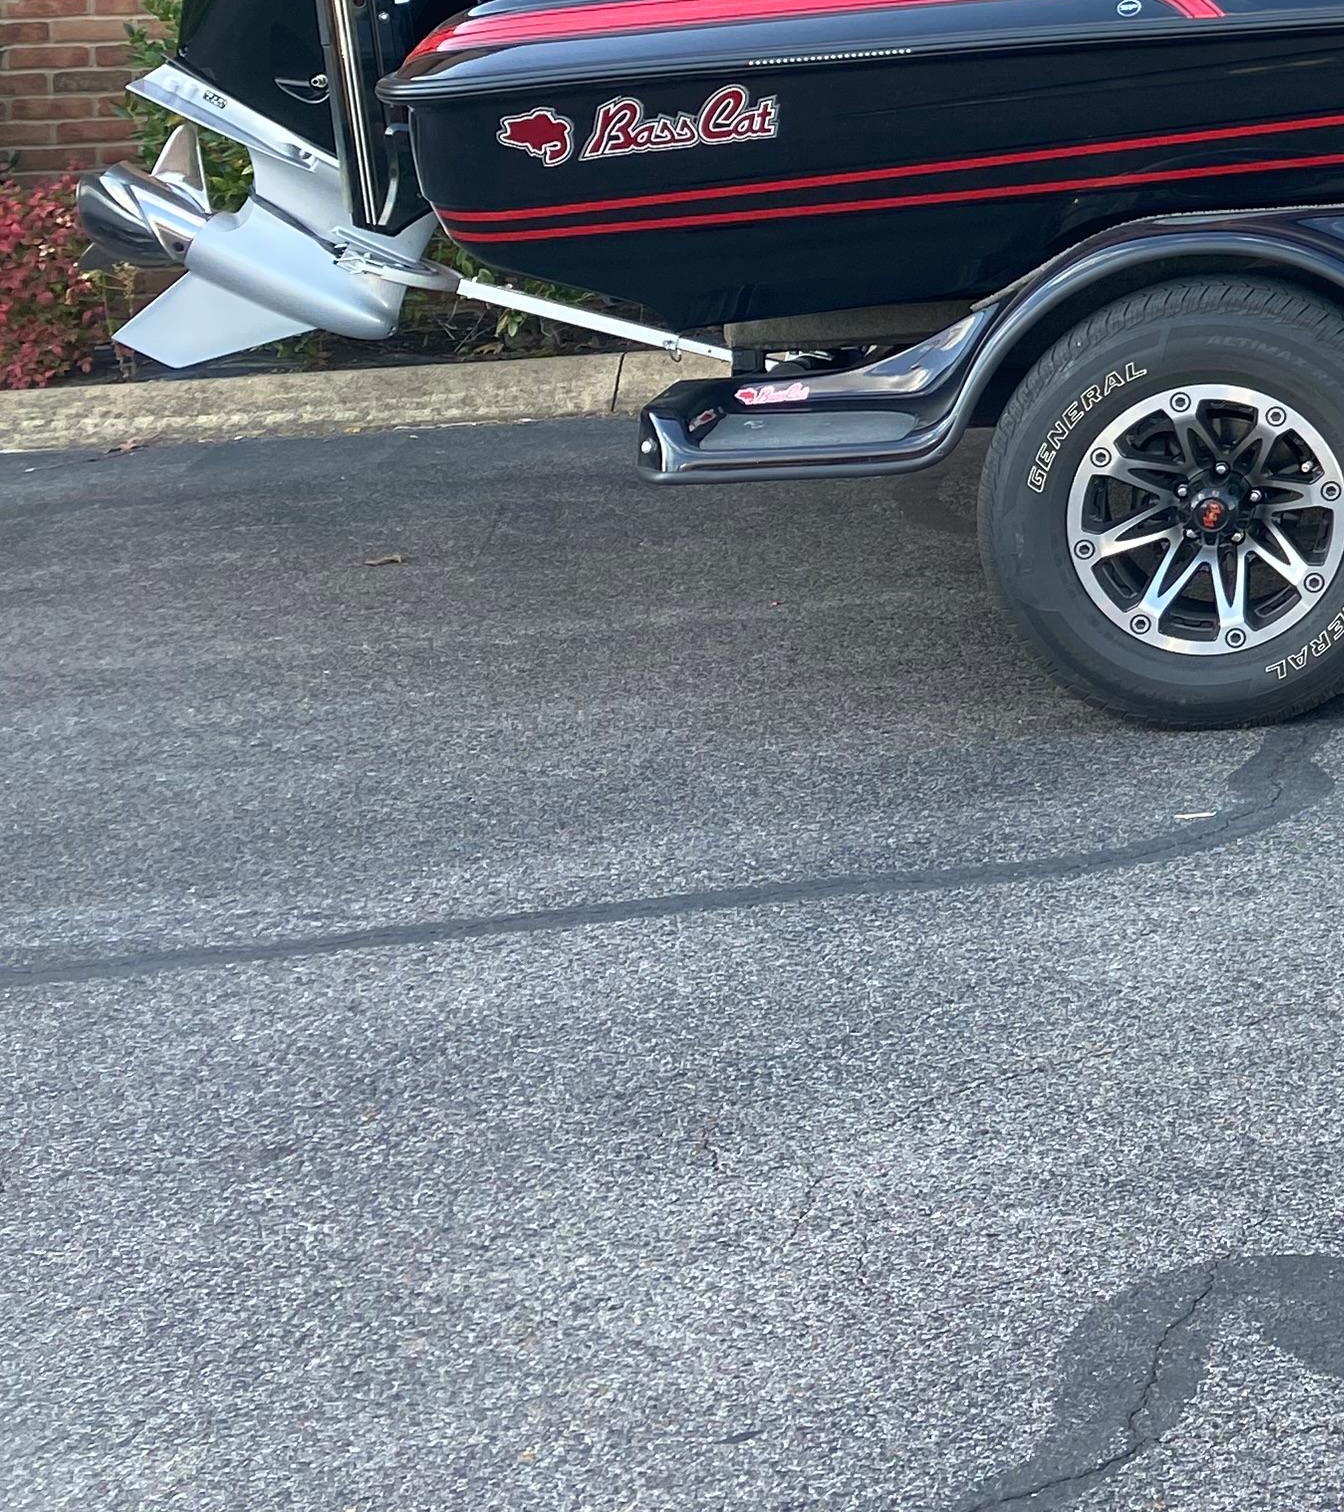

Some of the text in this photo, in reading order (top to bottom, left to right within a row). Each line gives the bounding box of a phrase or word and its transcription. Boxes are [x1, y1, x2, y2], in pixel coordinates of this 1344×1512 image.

[579, 84, 780, 161] Bass Cat
[1026, 361, 1147, 493] GENERAL
